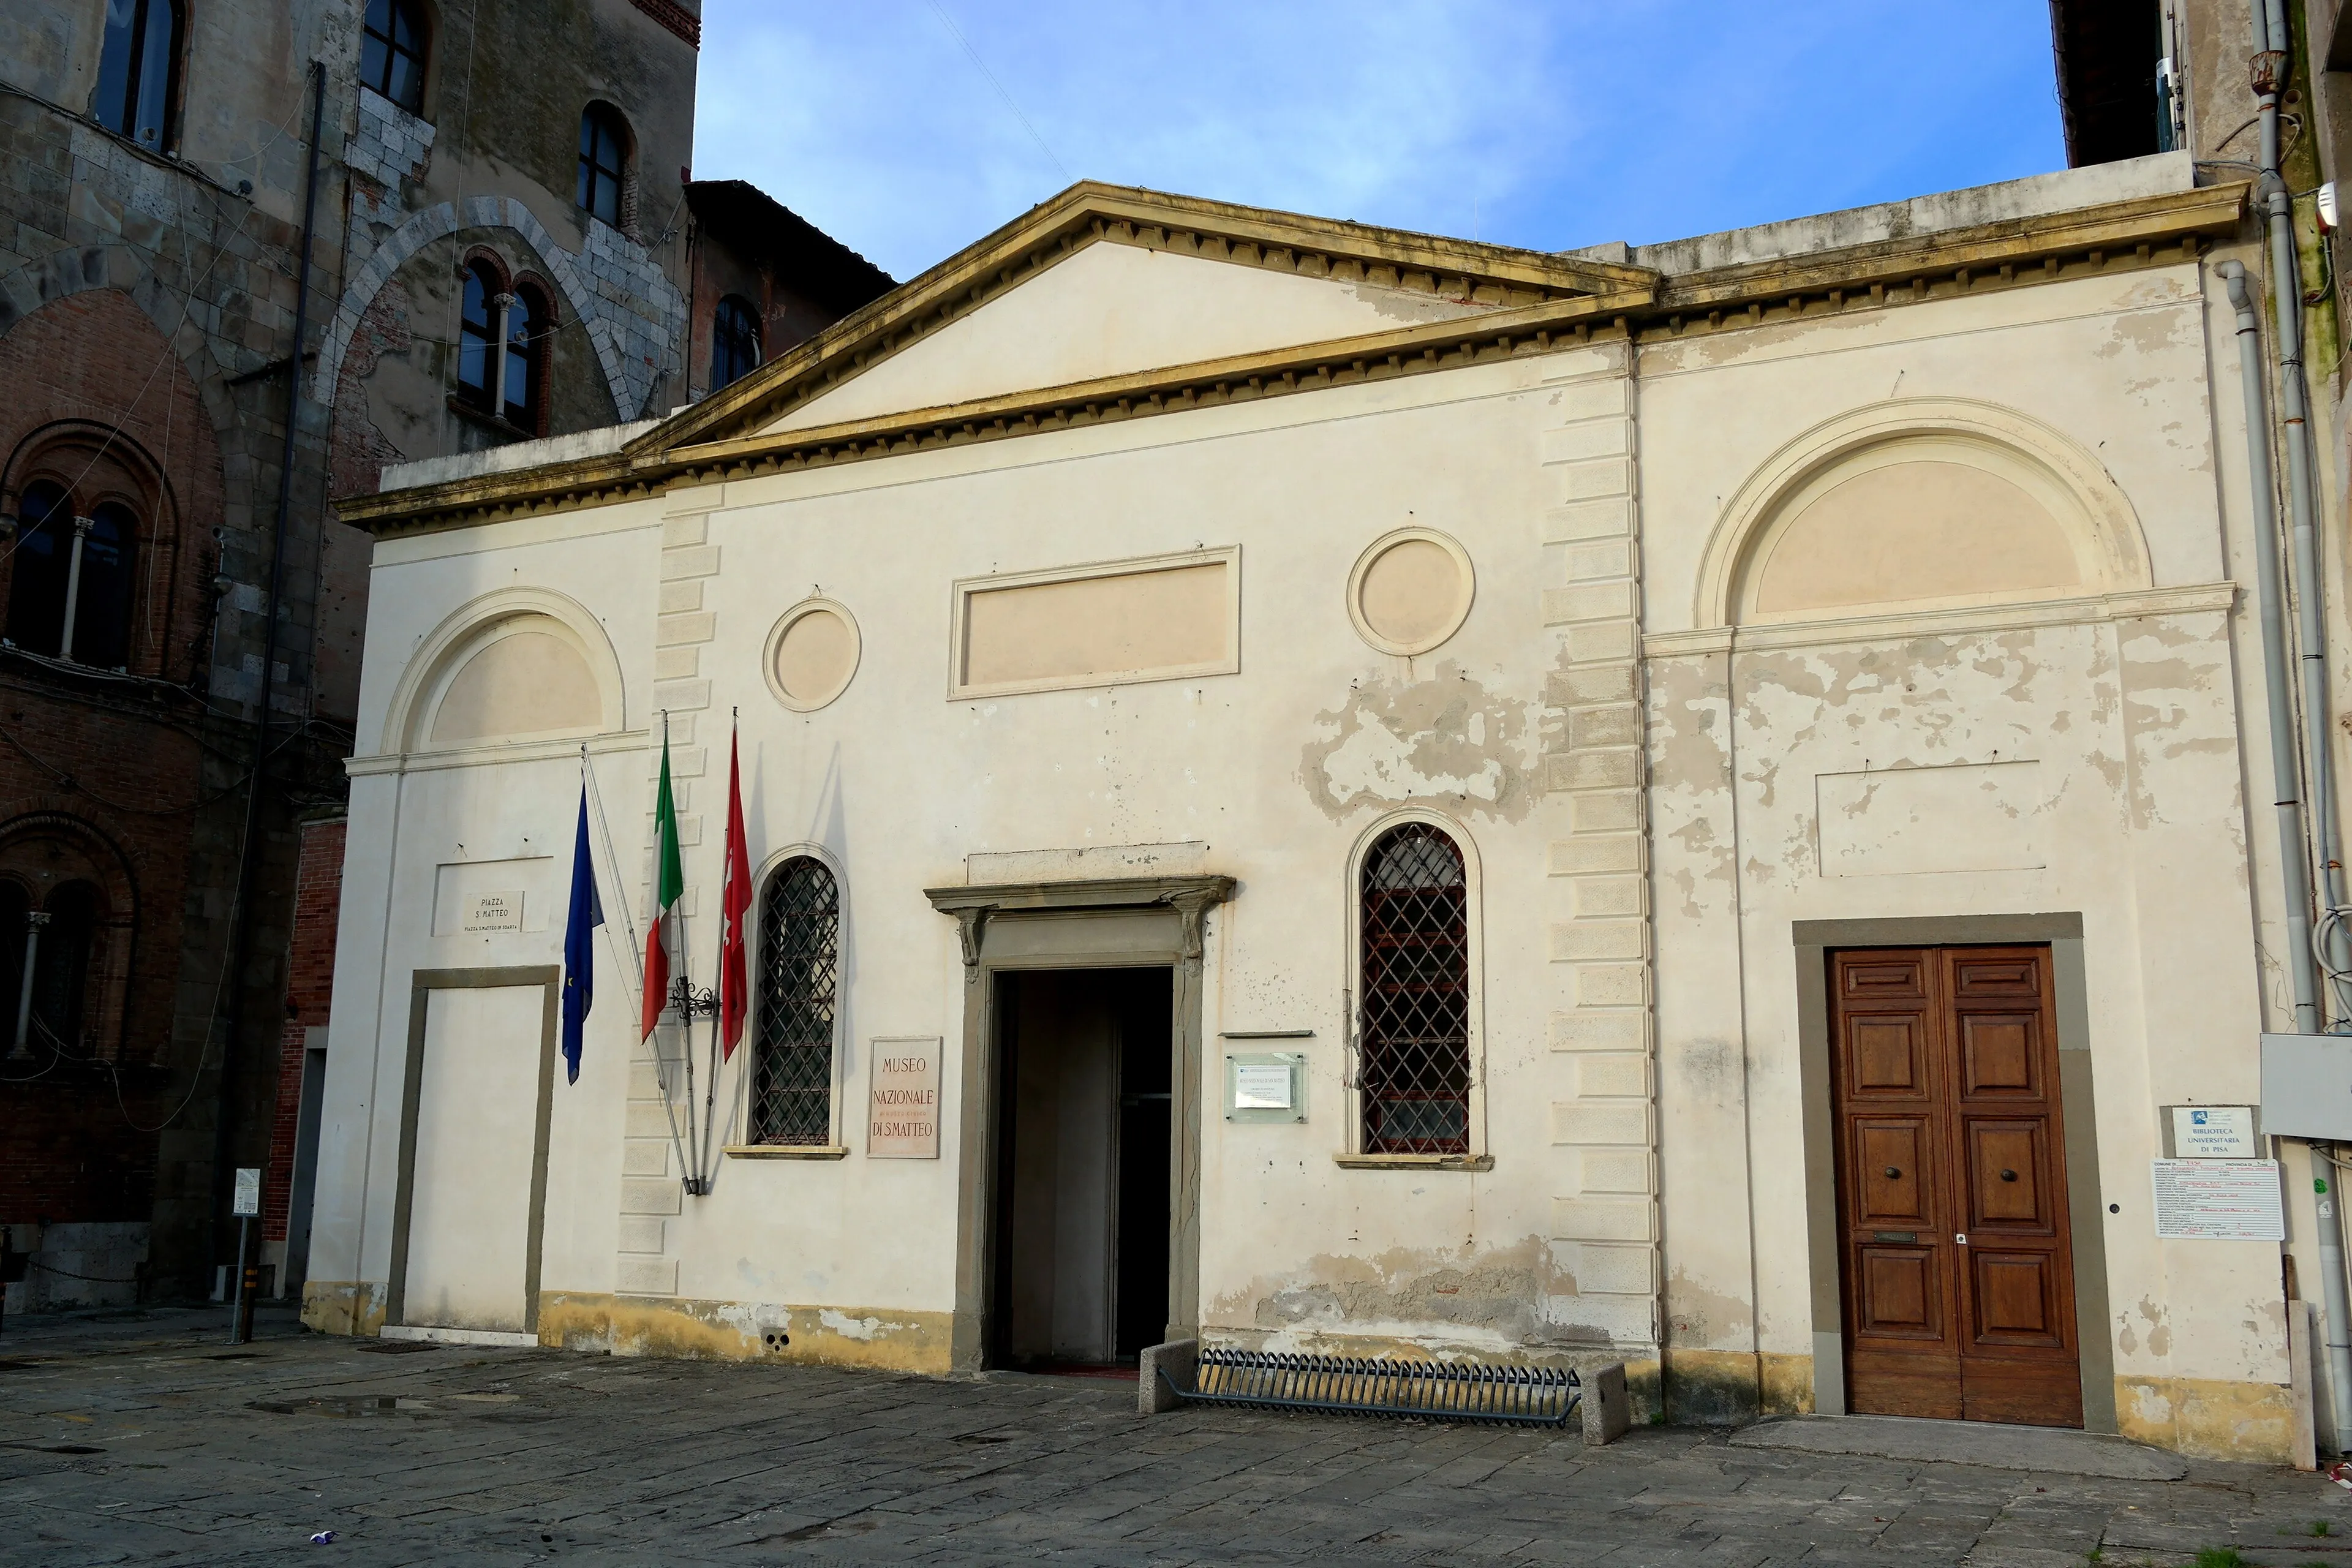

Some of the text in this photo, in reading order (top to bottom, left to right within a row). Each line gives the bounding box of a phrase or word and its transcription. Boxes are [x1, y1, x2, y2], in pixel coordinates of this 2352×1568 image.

[483, 909, 508, 918] MATTEO
[883, 1058, 925, 1072] MUSEO
[873, 1090, 933, 1104] NAZIONALE
[873, 1122, 882, 1136] DI
